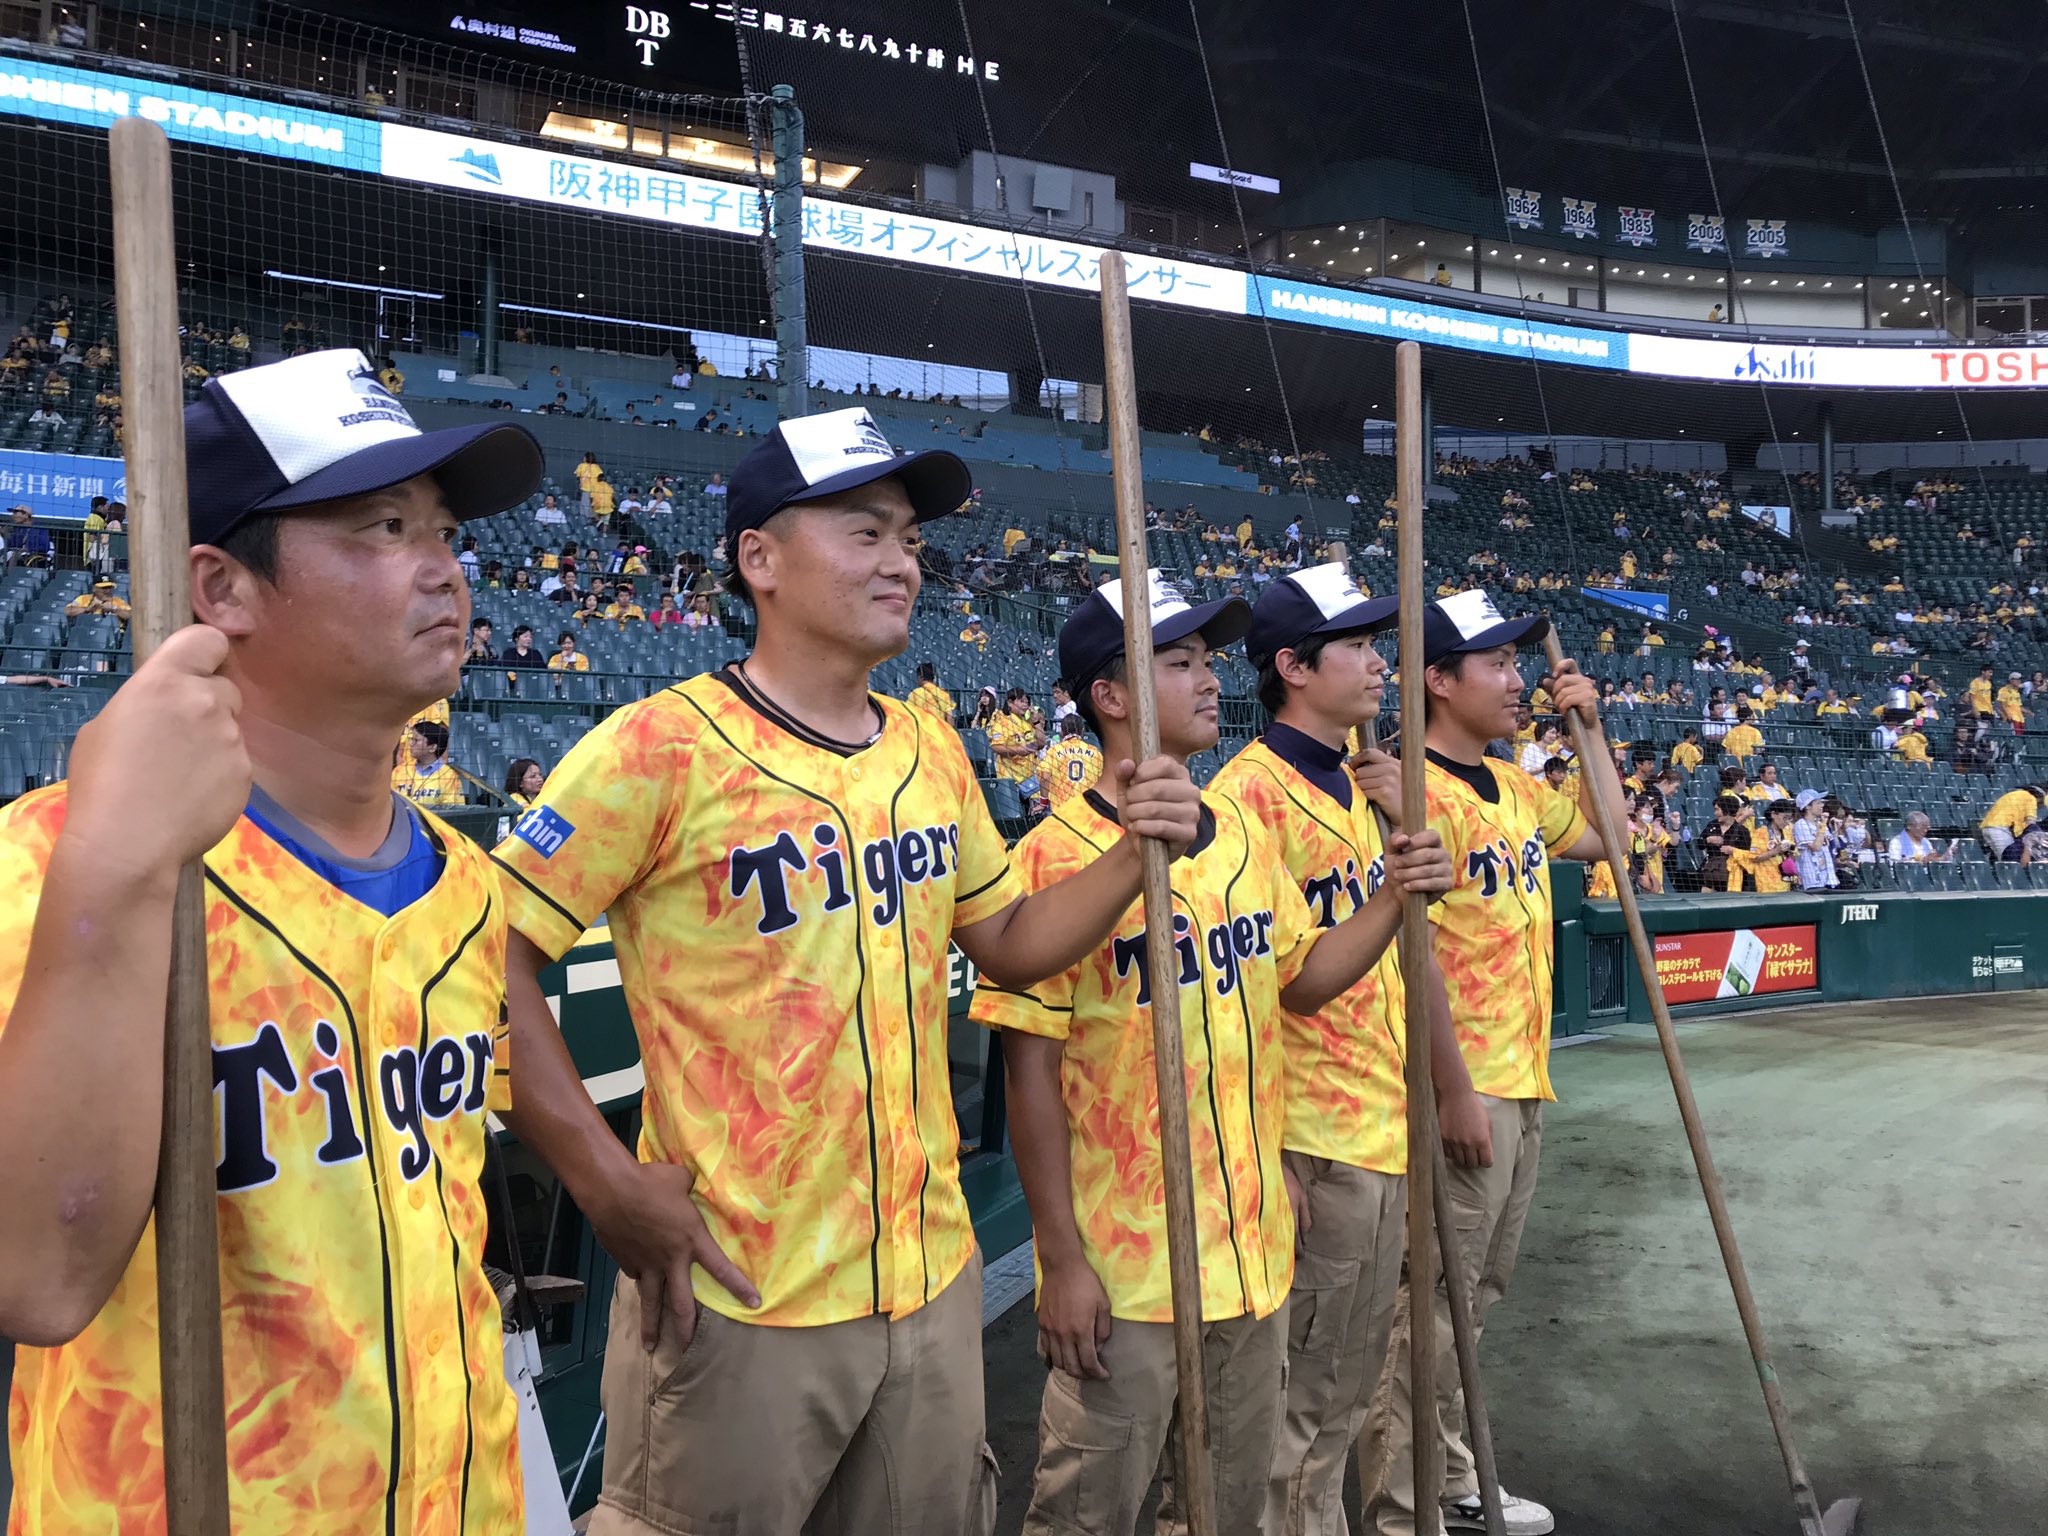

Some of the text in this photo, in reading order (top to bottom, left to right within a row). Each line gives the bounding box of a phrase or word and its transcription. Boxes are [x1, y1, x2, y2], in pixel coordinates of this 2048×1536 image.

[625, 5, 671, 39] DB
[519, 27, 561, 42] OKUMURA
[519, 35, 577, 53] CORPORATION
[635, 38, 661, 66] T
[957, 55, 974, 76] H
[985, 61, 1000, 81] E
[138, 96, 344, 152] STADIUM
[1508, 198, 1540, 218] 1962
[1565, 207, 1595, 228] 1964
[1621, 216, 1652, 235] 1985
[1689, 224, 1724, 241] 2003
[1748, 229, 1786, 245] 2005
[1271, 289, 1609, 358] HANSHIN KOSHIEN STADIUM
[0, 469, 104, 498] 毎日新聞
[1056, 747, 1095, 759] KINAMI
[730, 821, 959, 936] Tigers
[1840, 904, 1880, 925] JTEKT
[1655, 942, 1682, 952] SUNSTAR
[1766, 943, 1803, 959] サンスター
[1113, 908, 1274, 1008] Tiger
[1656, 957, 1702, 973] 野菜のチカラで
[211, 1018, 494, 1184] Tiger
